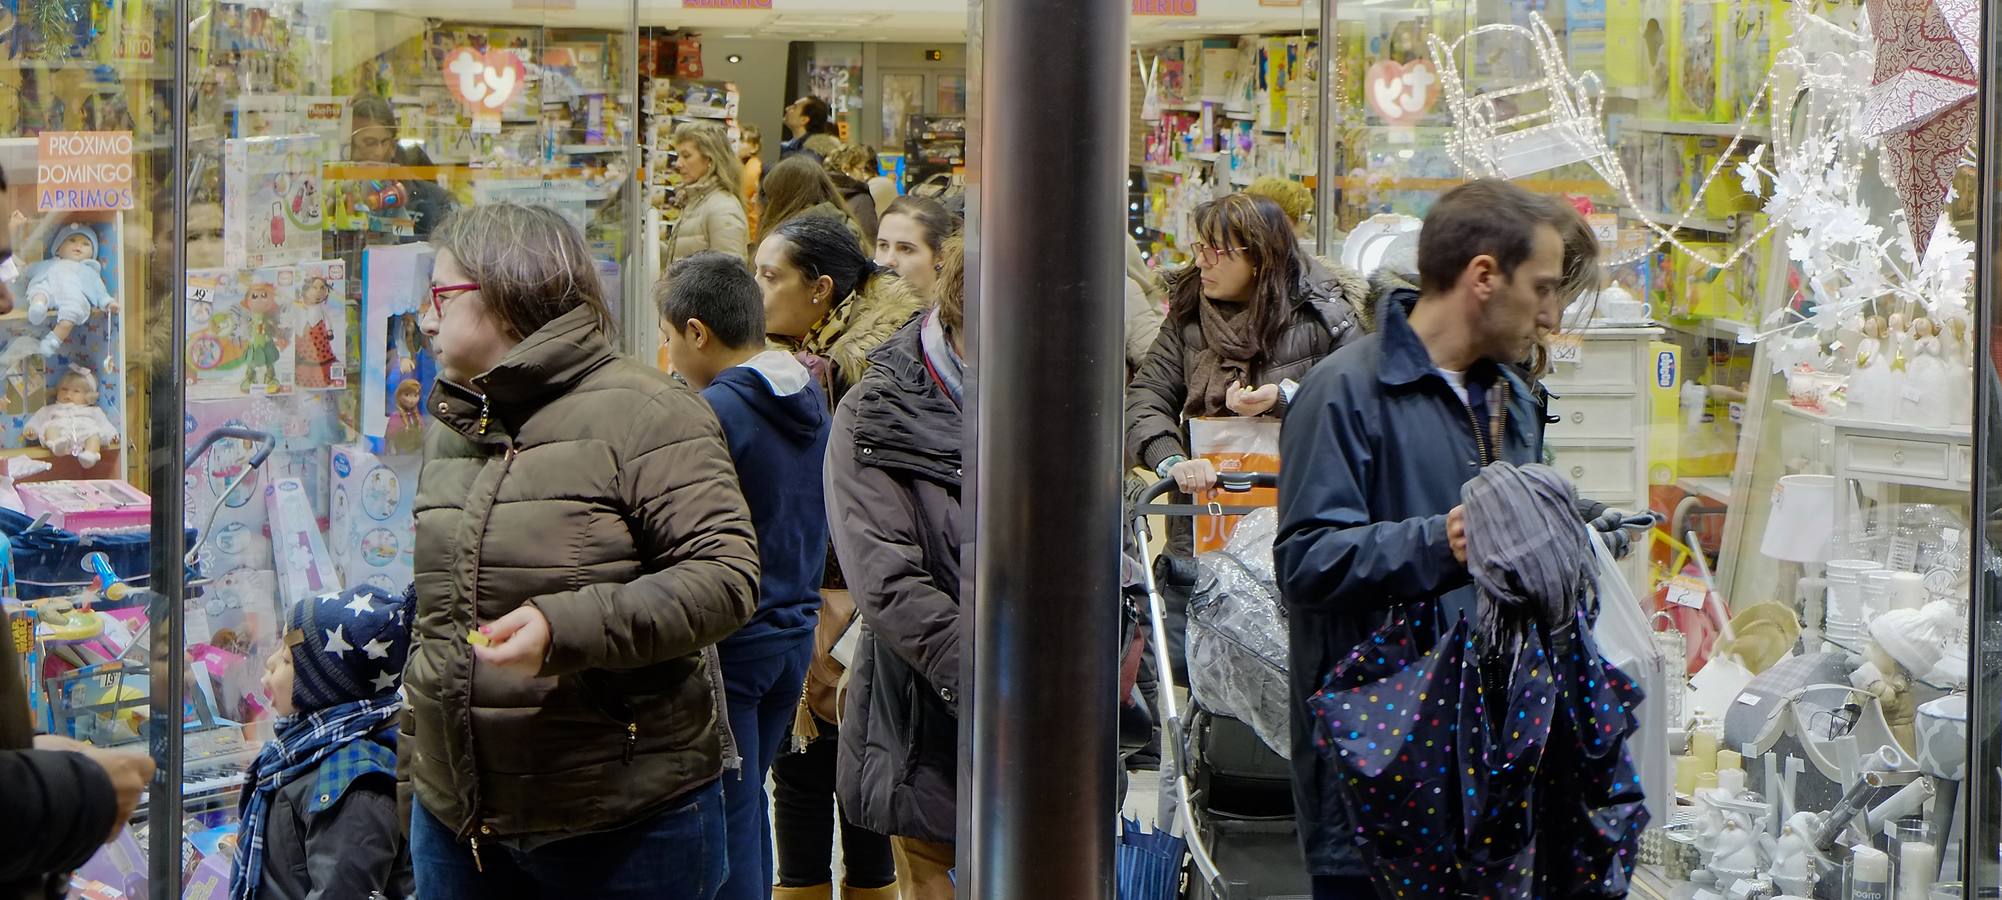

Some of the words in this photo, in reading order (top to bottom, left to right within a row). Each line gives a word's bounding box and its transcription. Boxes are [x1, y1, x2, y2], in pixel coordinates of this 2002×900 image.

[448, 51, 517, 109] ty
[48, 130, 133, 156] PRÓXIMO
[37, 163, 133, 185] DOMINGO
[40, 187, 133, 210] ABRIMOS
